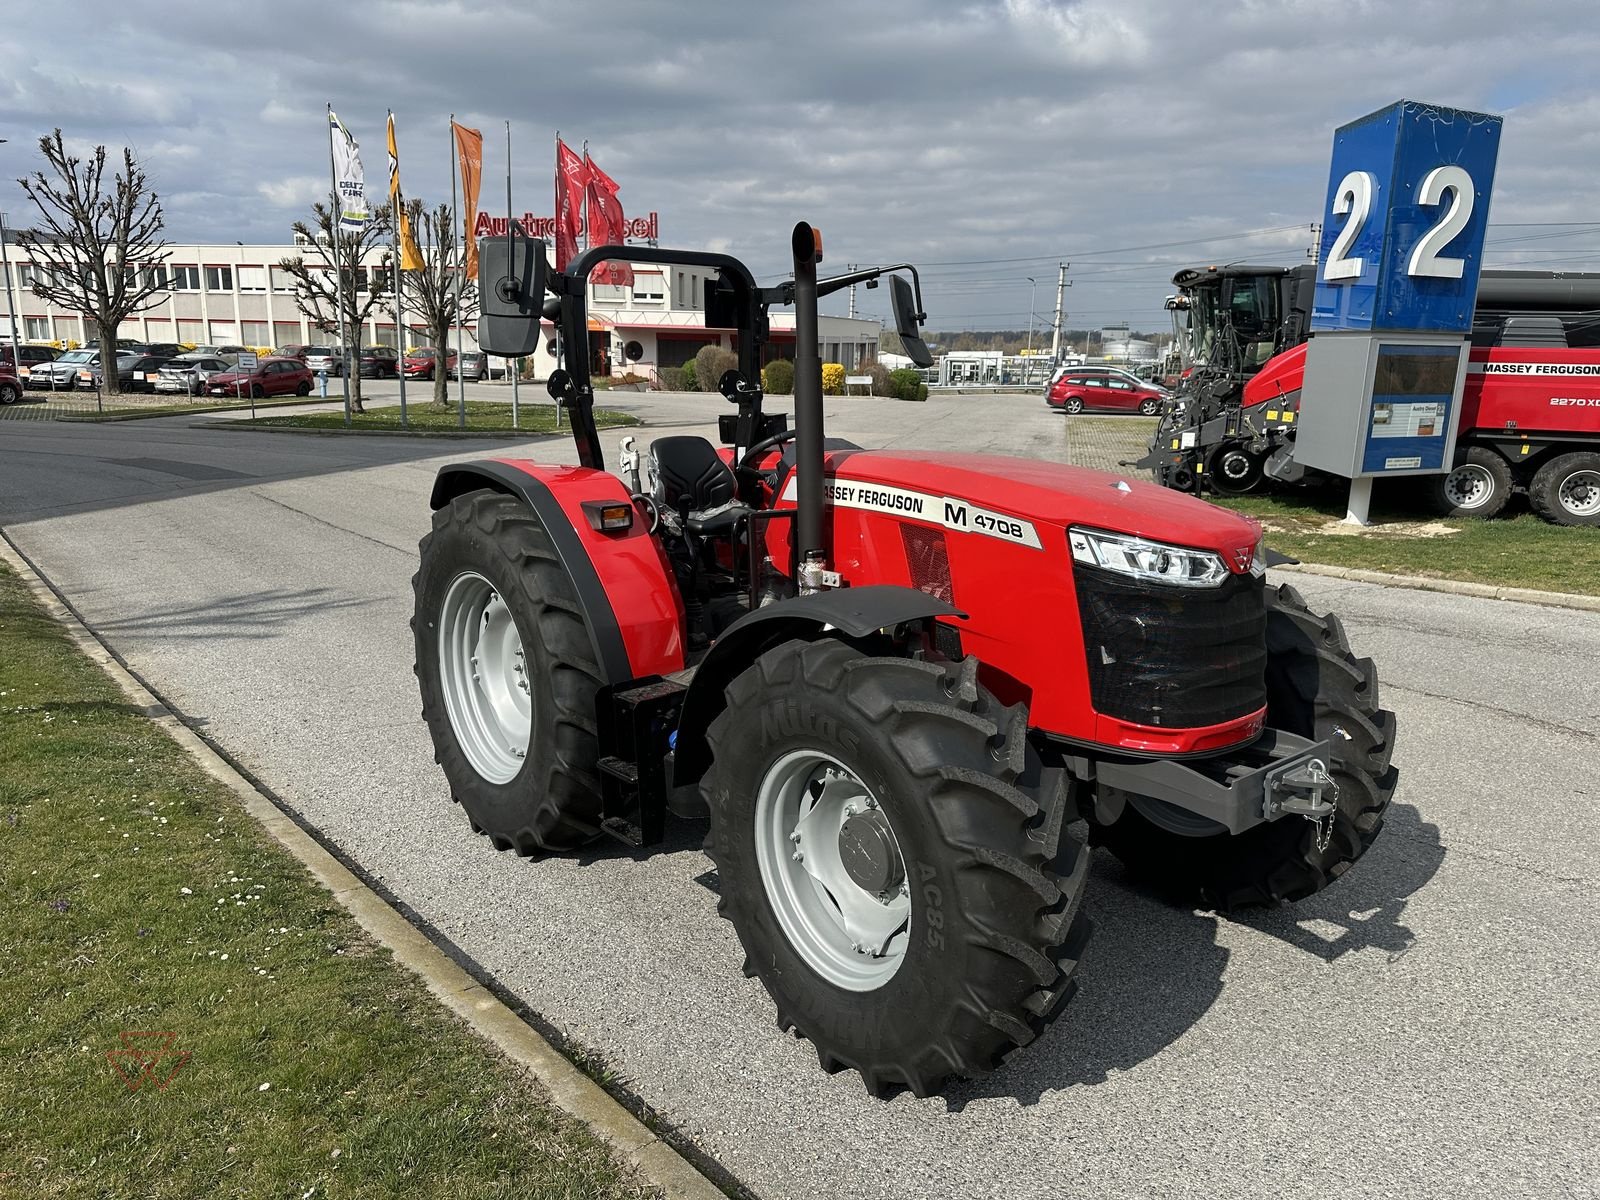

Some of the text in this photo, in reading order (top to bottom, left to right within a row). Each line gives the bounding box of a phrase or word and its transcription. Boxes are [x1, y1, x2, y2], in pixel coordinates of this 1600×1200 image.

[1323, 171, 1372, 280] 2
[1408, 165, 1475, 279] 2
[1482, 363, 1600, 375] MASSEY FERGUSON
[824, 486, 1024, 539] ASSEY FERGUSON M 4708
[917, 860, 945, 952] AC85
